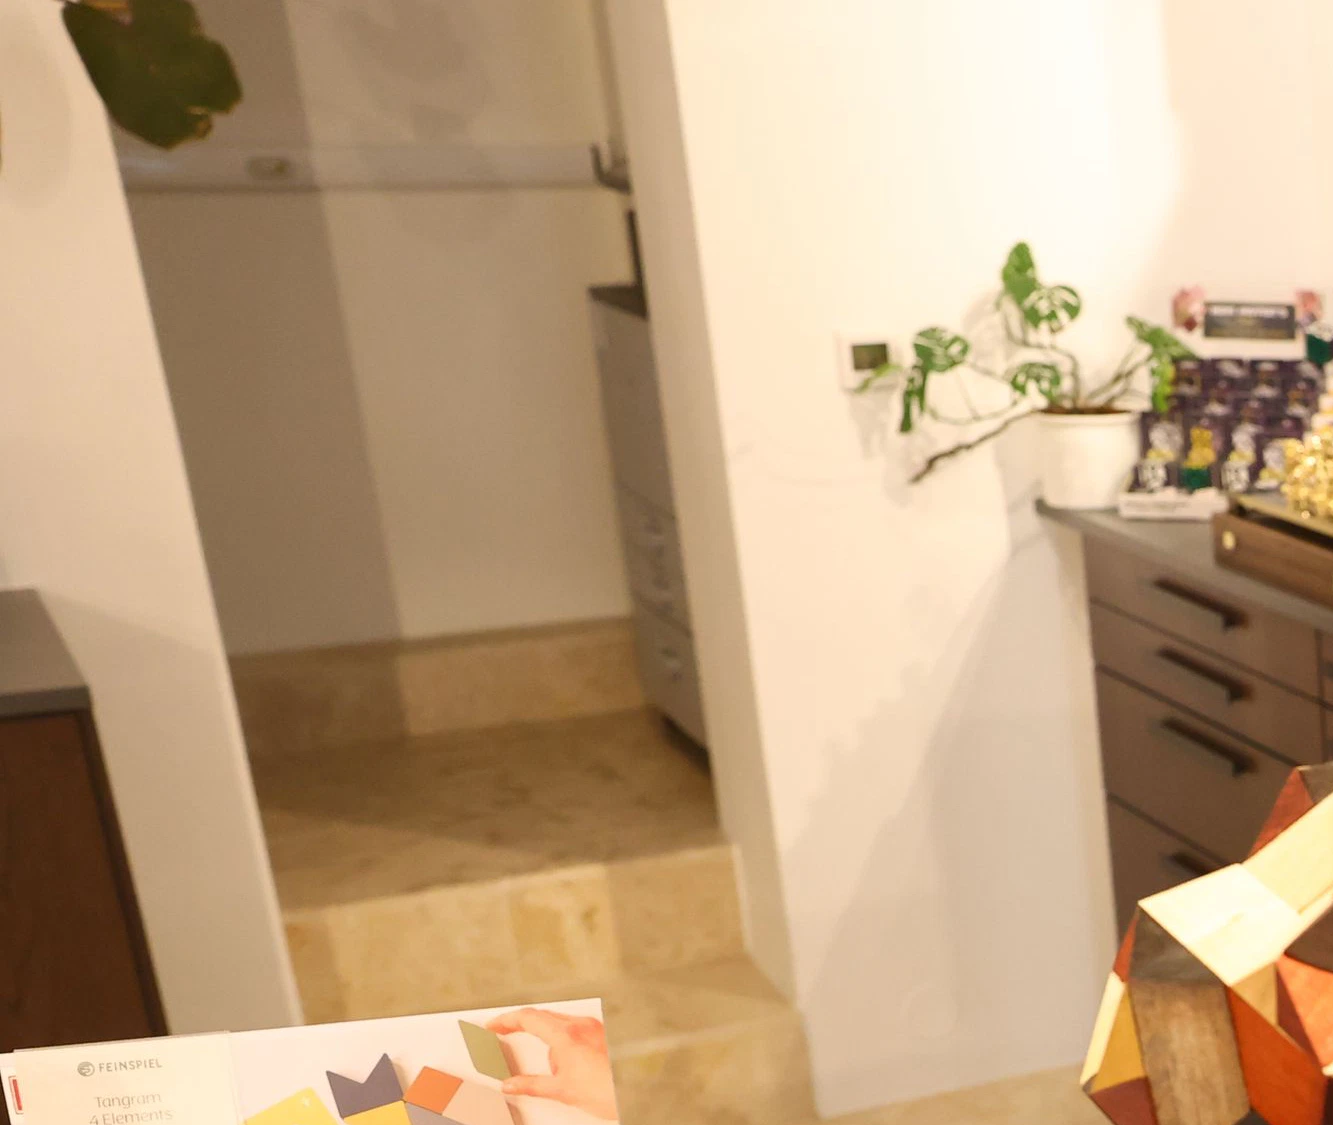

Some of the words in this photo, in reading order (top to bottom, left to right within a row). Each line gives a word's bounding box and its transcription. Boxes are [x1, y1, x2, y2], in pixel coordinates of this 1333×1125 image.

[99, 1058, 163, 1073] FEINSPIEL
[94, 1092, 162, 1109] Tangram
[102, 1110, 173, 1125] Elements
